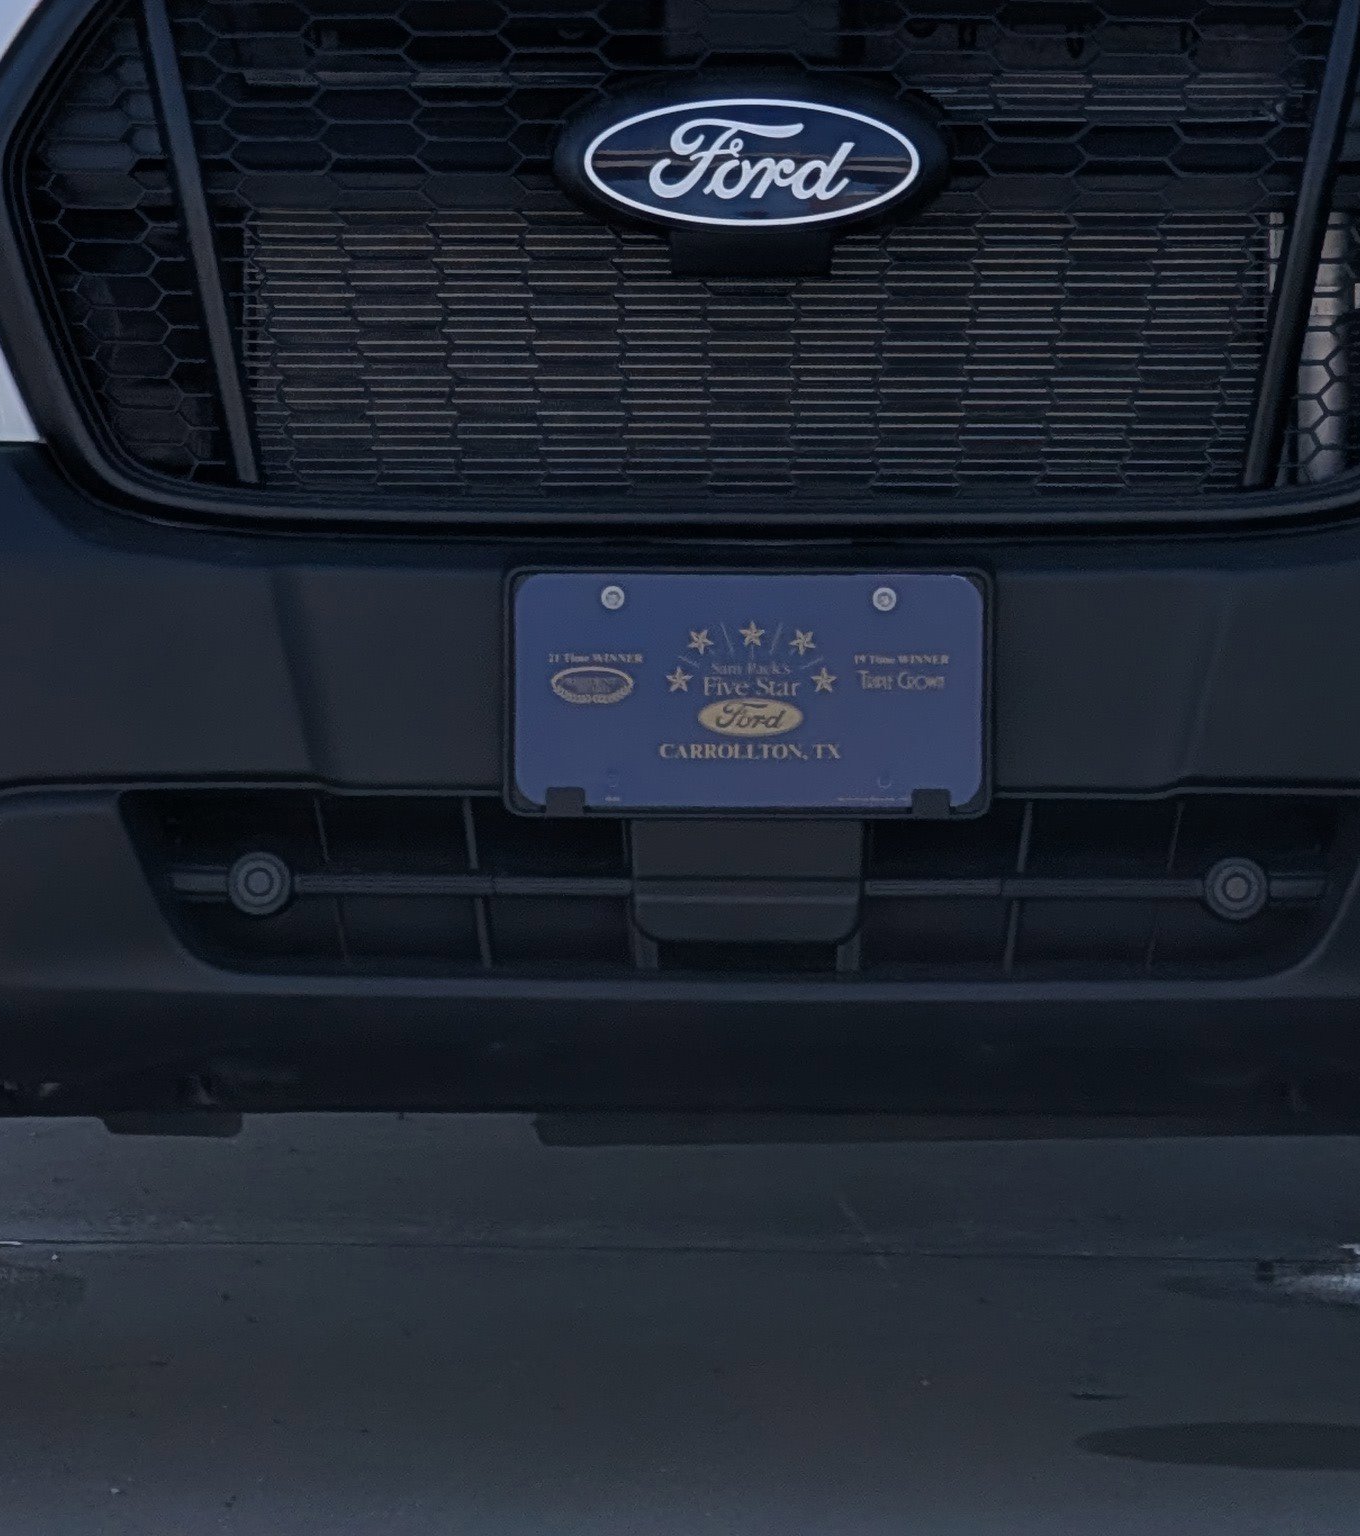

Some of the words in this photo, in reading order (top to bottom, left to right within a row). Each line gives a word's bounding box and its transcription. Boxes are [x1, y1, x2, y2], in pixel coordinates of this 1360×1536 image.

[648, 117, 856, 201] Ford
[703, 675, 750, 696] Five
[756, 675, 802, 696] Star
[715, 702, 787, 729] Ford
[659, 742, 809, 760] CARROLLTON,
[813, 743, 841, 760] TX
